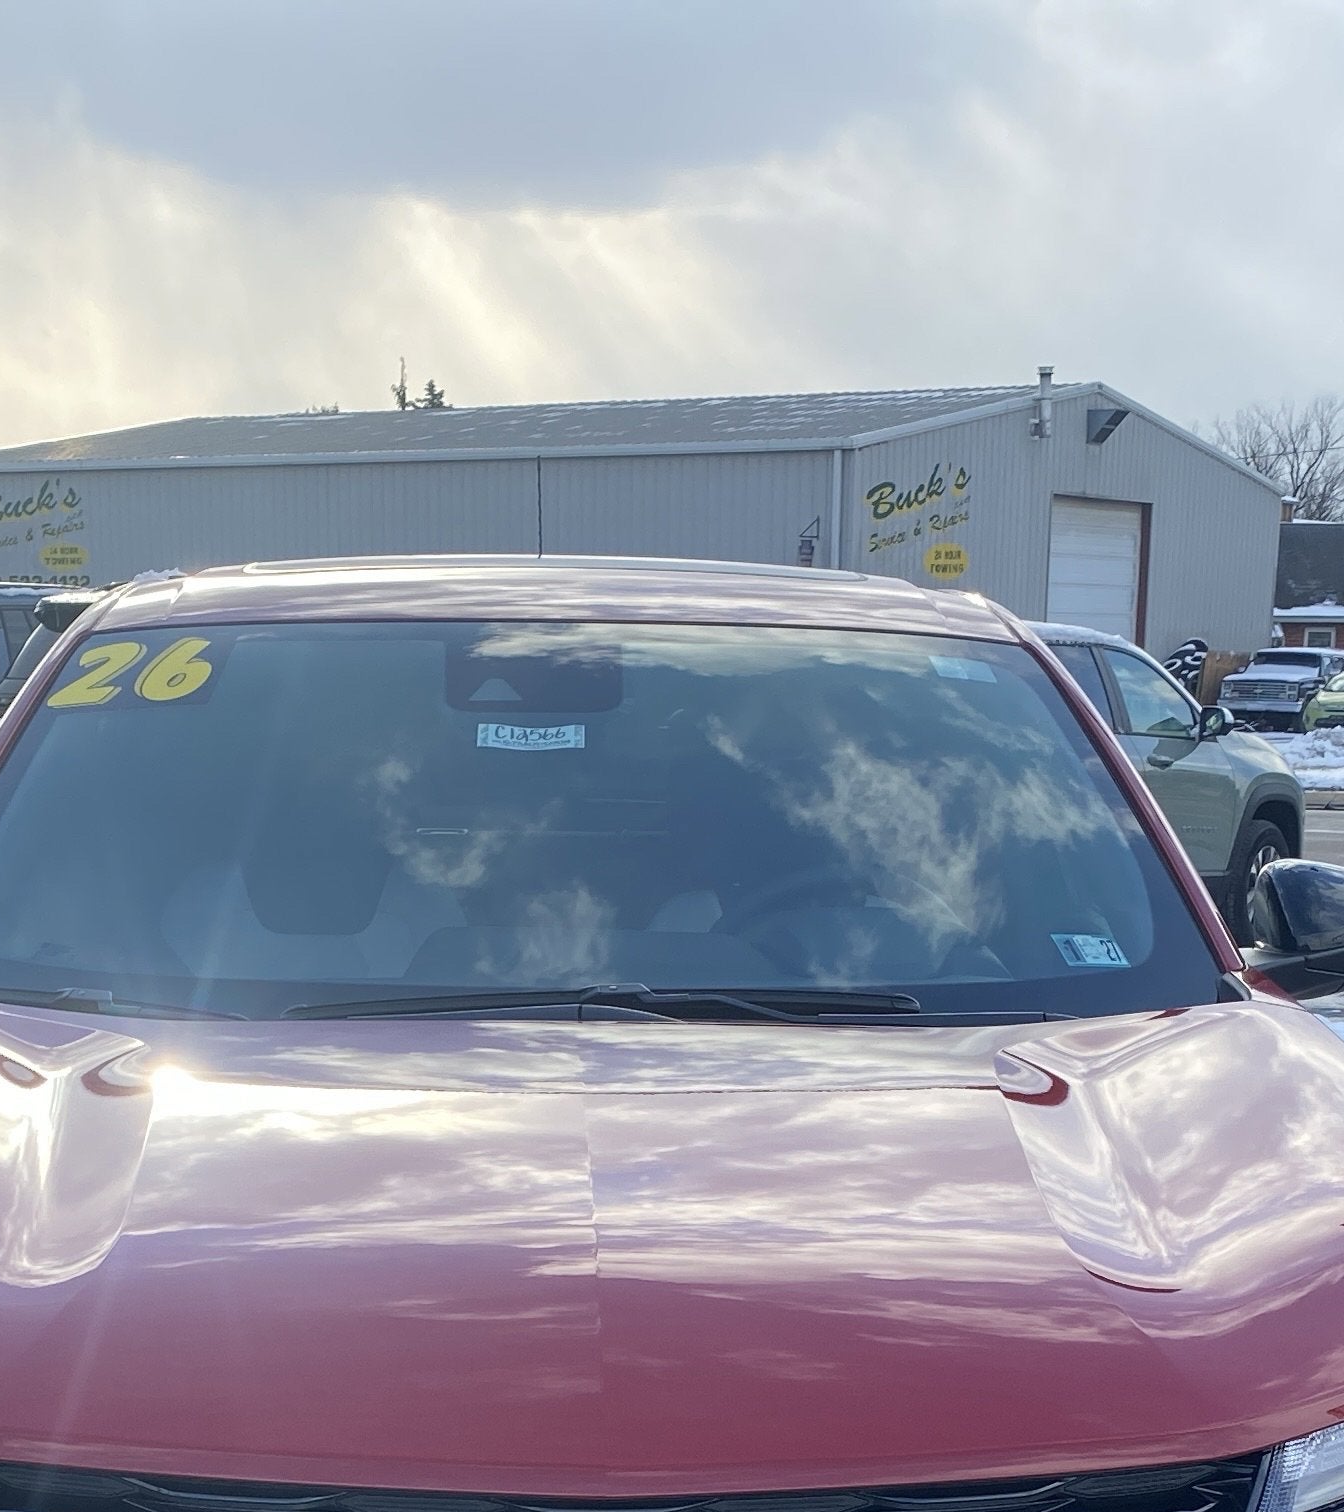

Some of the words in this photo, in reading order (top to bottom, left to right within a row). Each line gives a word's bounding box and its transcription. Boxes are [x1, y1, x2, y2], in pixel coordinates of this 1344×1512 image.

[867, 462, 971, 519] Buck's
[930, 563, 964, 573] TOWING
[47, 637, 213, 708] 26
